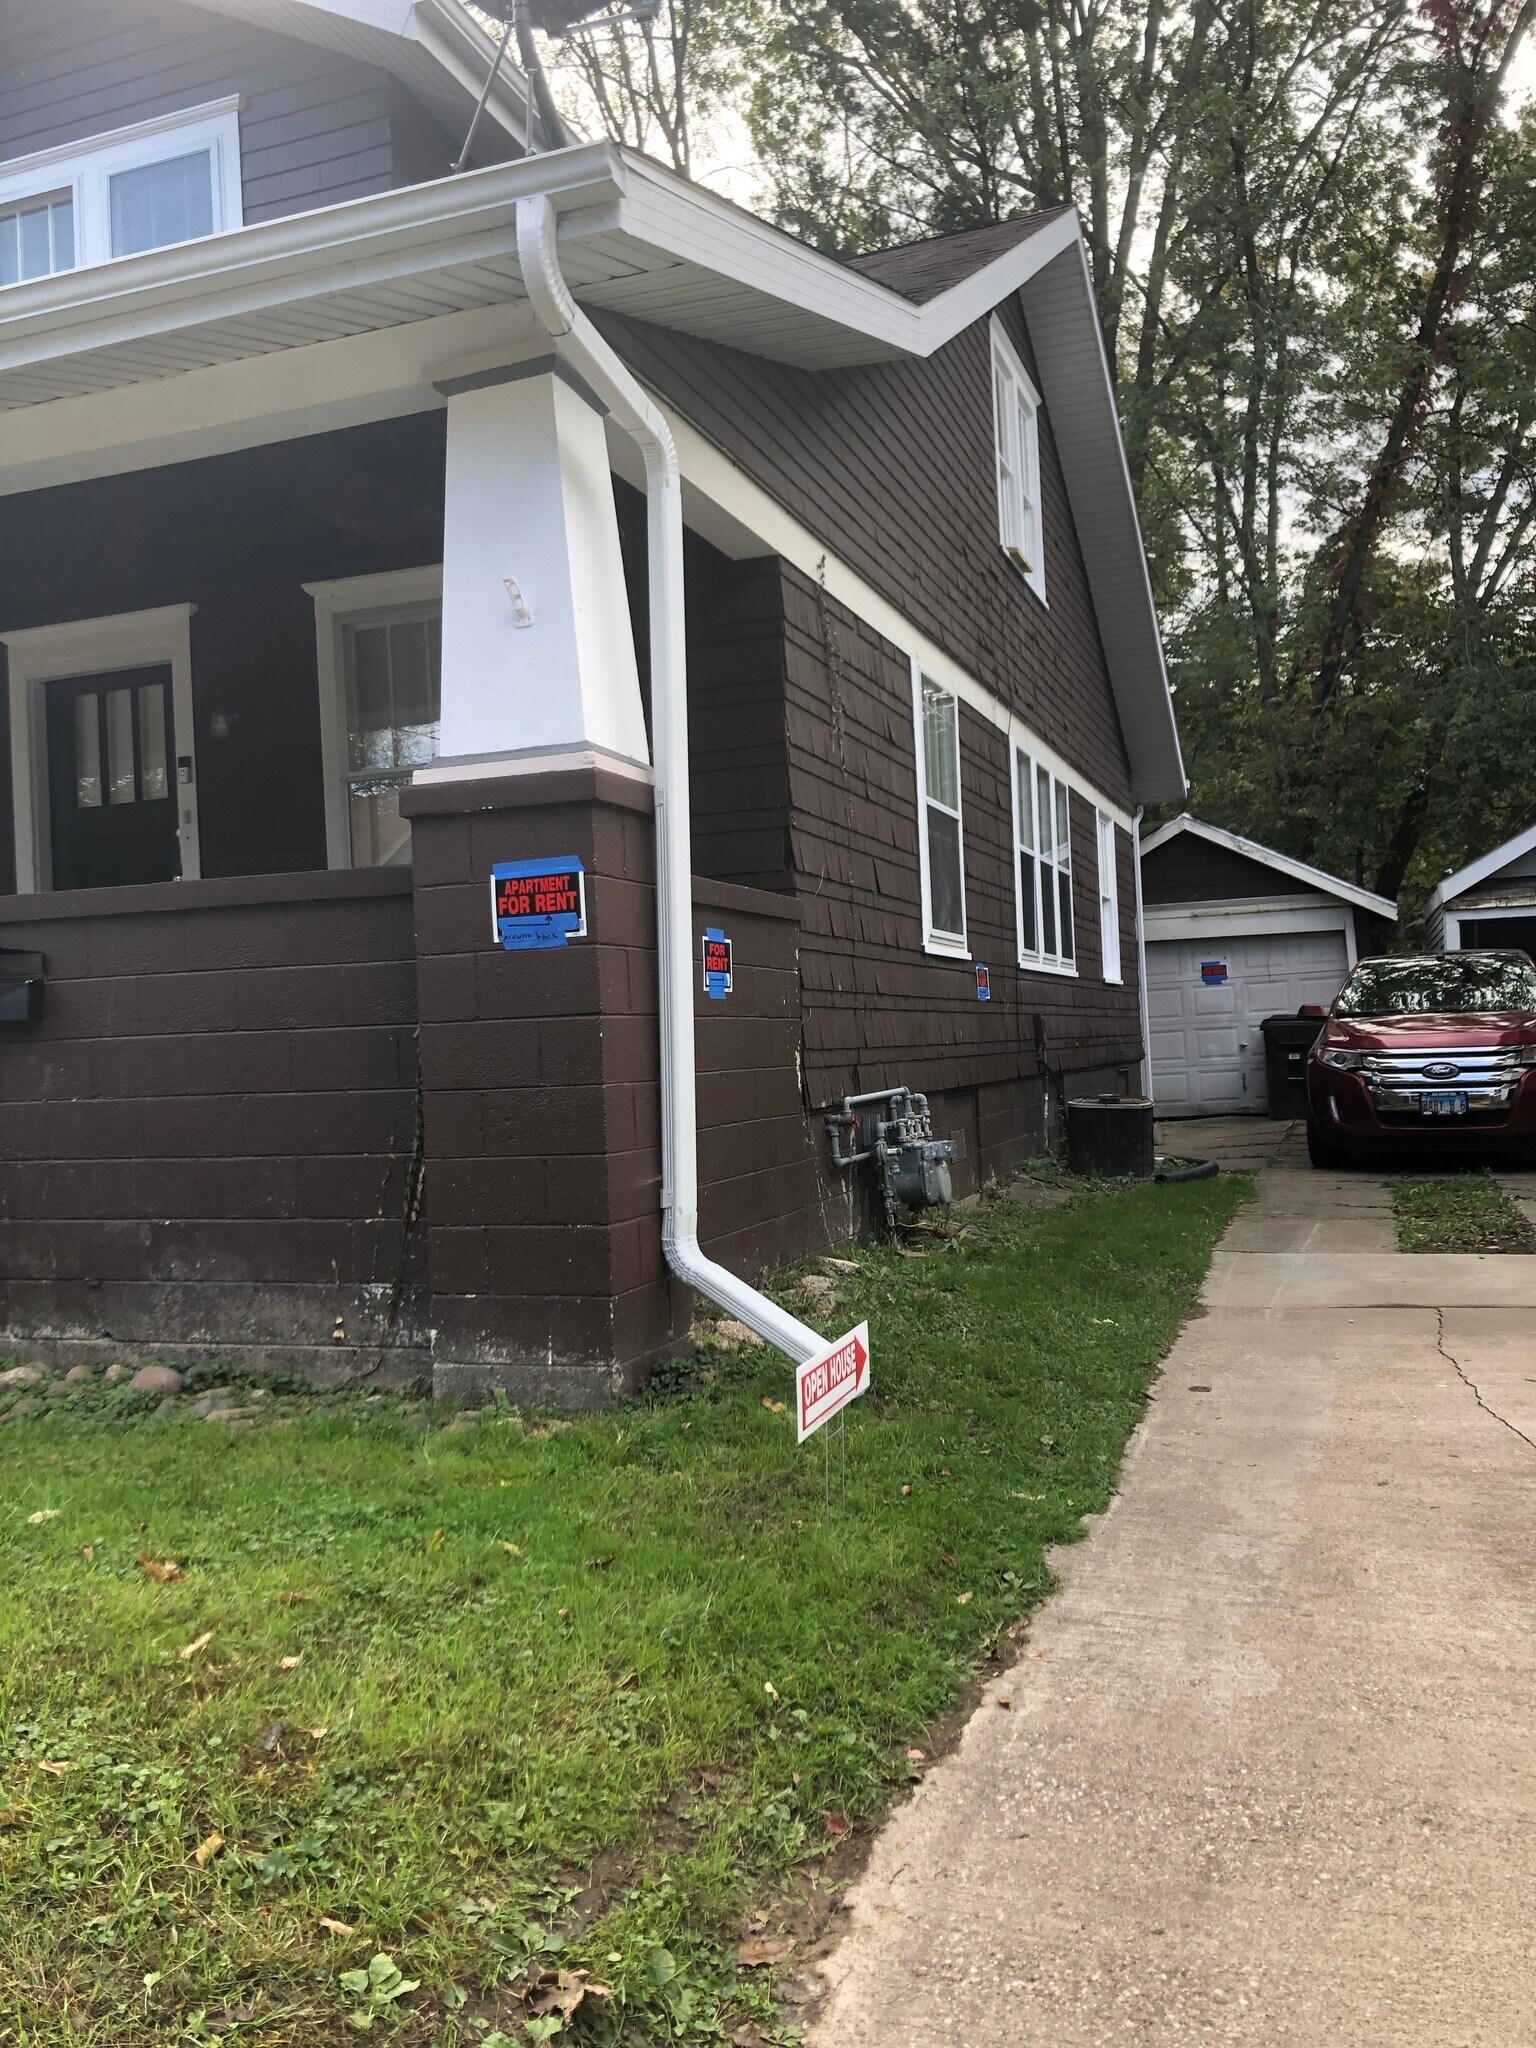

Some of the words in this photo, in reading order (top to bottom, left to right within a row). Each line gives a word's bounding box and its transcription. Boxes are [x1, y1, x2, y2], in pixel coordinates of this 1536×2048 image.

[505, 876, 570, 895] APARTMENT
[498, 895, 530, 915] FOR
[535, 891, 577, 912] RENT
[709, 943, 726, 956] FOR
[706, 956, 728, 971] RENT
[1422, 1099, 1443, 1111] BABY
[1460, 1099, 1466, 1110] 6
[804, 1362, 828, 1406] OPEN
[830, 1341, 857, 1389] HOUSE
